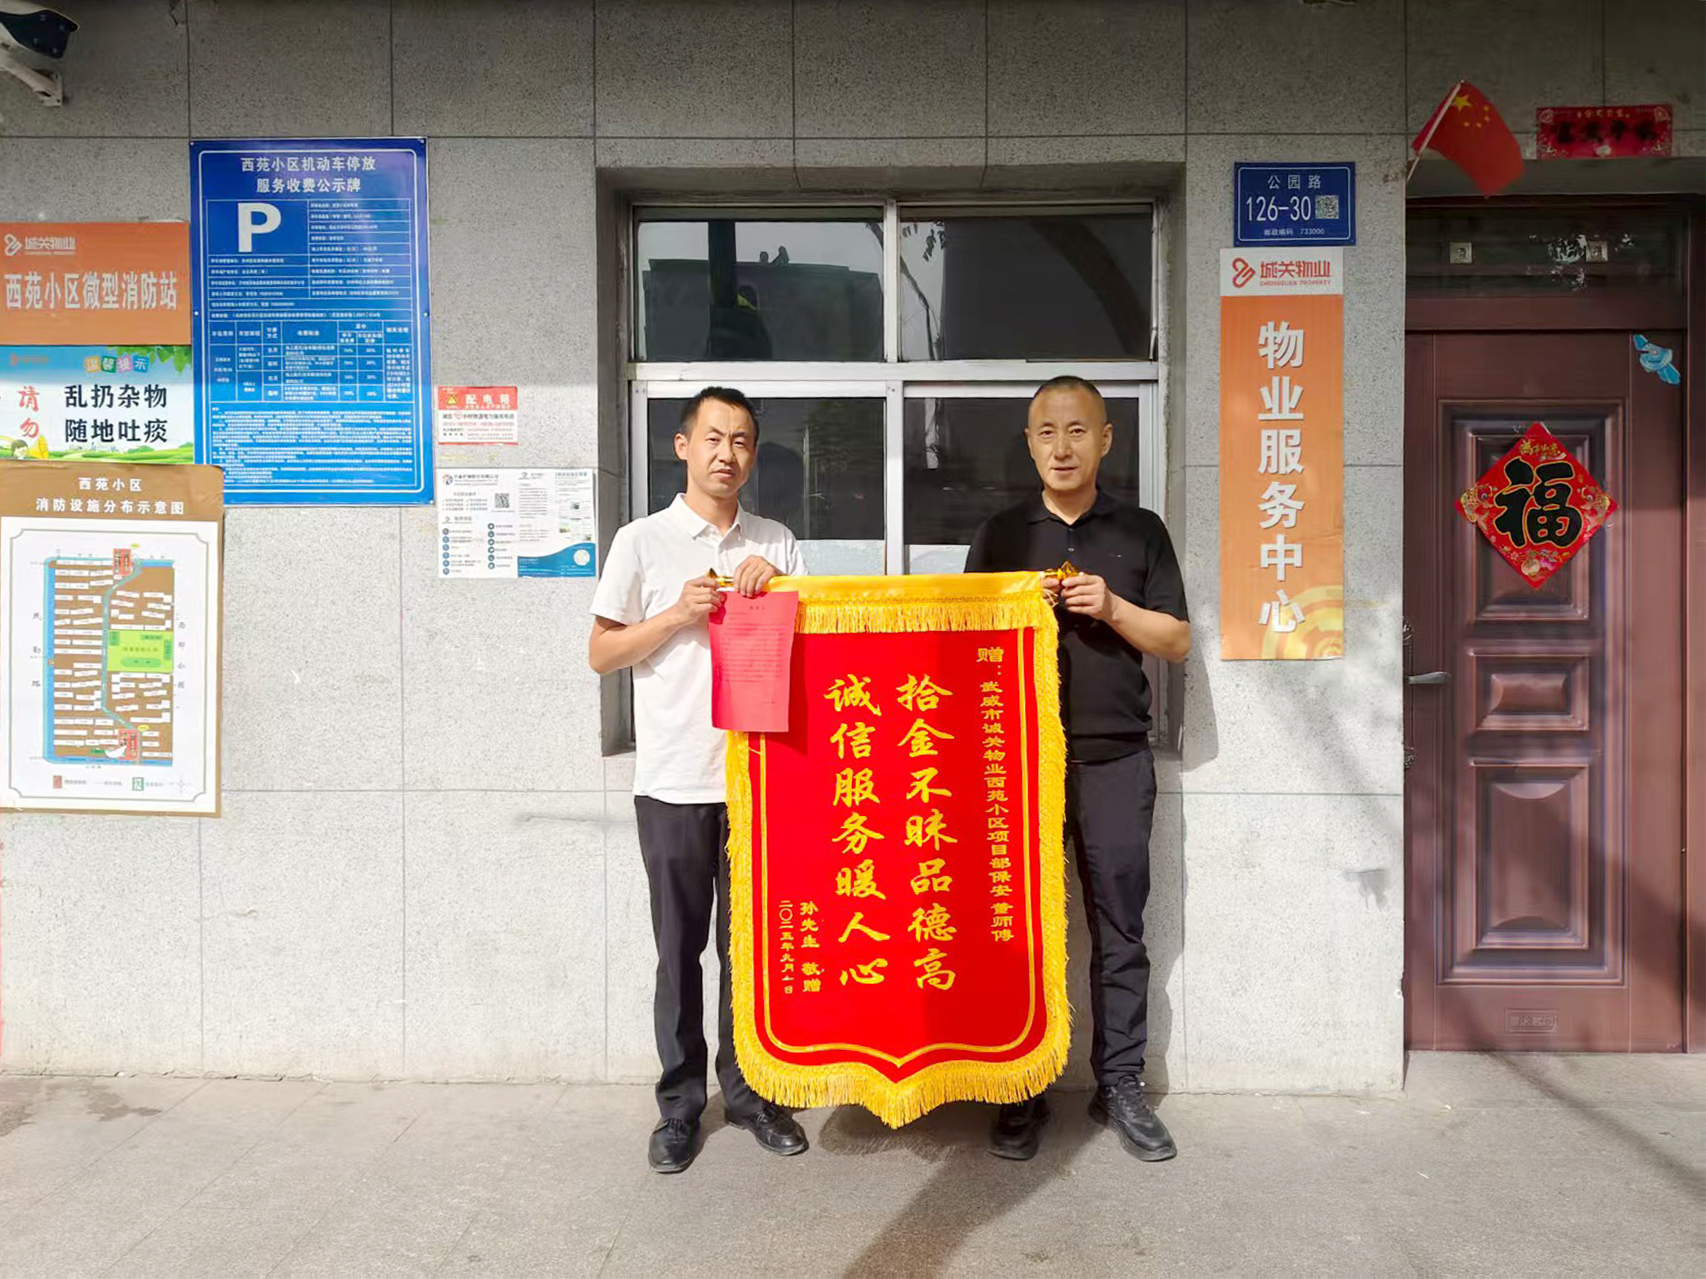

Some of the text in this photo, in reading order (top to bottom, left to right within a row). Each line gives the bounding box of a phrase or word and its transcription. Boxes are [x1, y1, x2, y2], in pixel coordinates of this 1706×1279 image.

[241, 156, 376, 172] 西苑小区机动车停放
[257, 178, 361, 193] 服务收费公示牌
[1267, 175, 1321, 189] 公园路
[1246, 196, 1311, 221] 126-30
[238, 202, 282, 252] P
[25, 236, 76, 250] 城关物业
[1260, 260, 1330, 279] 城关物业
[4, 272, 177, 310] 西苑小区微型消防站
[64, 384, 168, 408] 乱扔杂物
[17, 386, 40, 438] 请勿
[65, 419, 168, 443] 随地吐痰
[79, 477, 142, 492] 西苑小区
[1258, 321, 1305, 633] 物业服务中心
[36, 498, 184, 514] 消防设施分布示意图
[1493, 456, 1583, 548] 福
[824, 674, 890, 985] 诚信服务暖人心
[896, 674, 957, 990] 拾金不昧品德高
